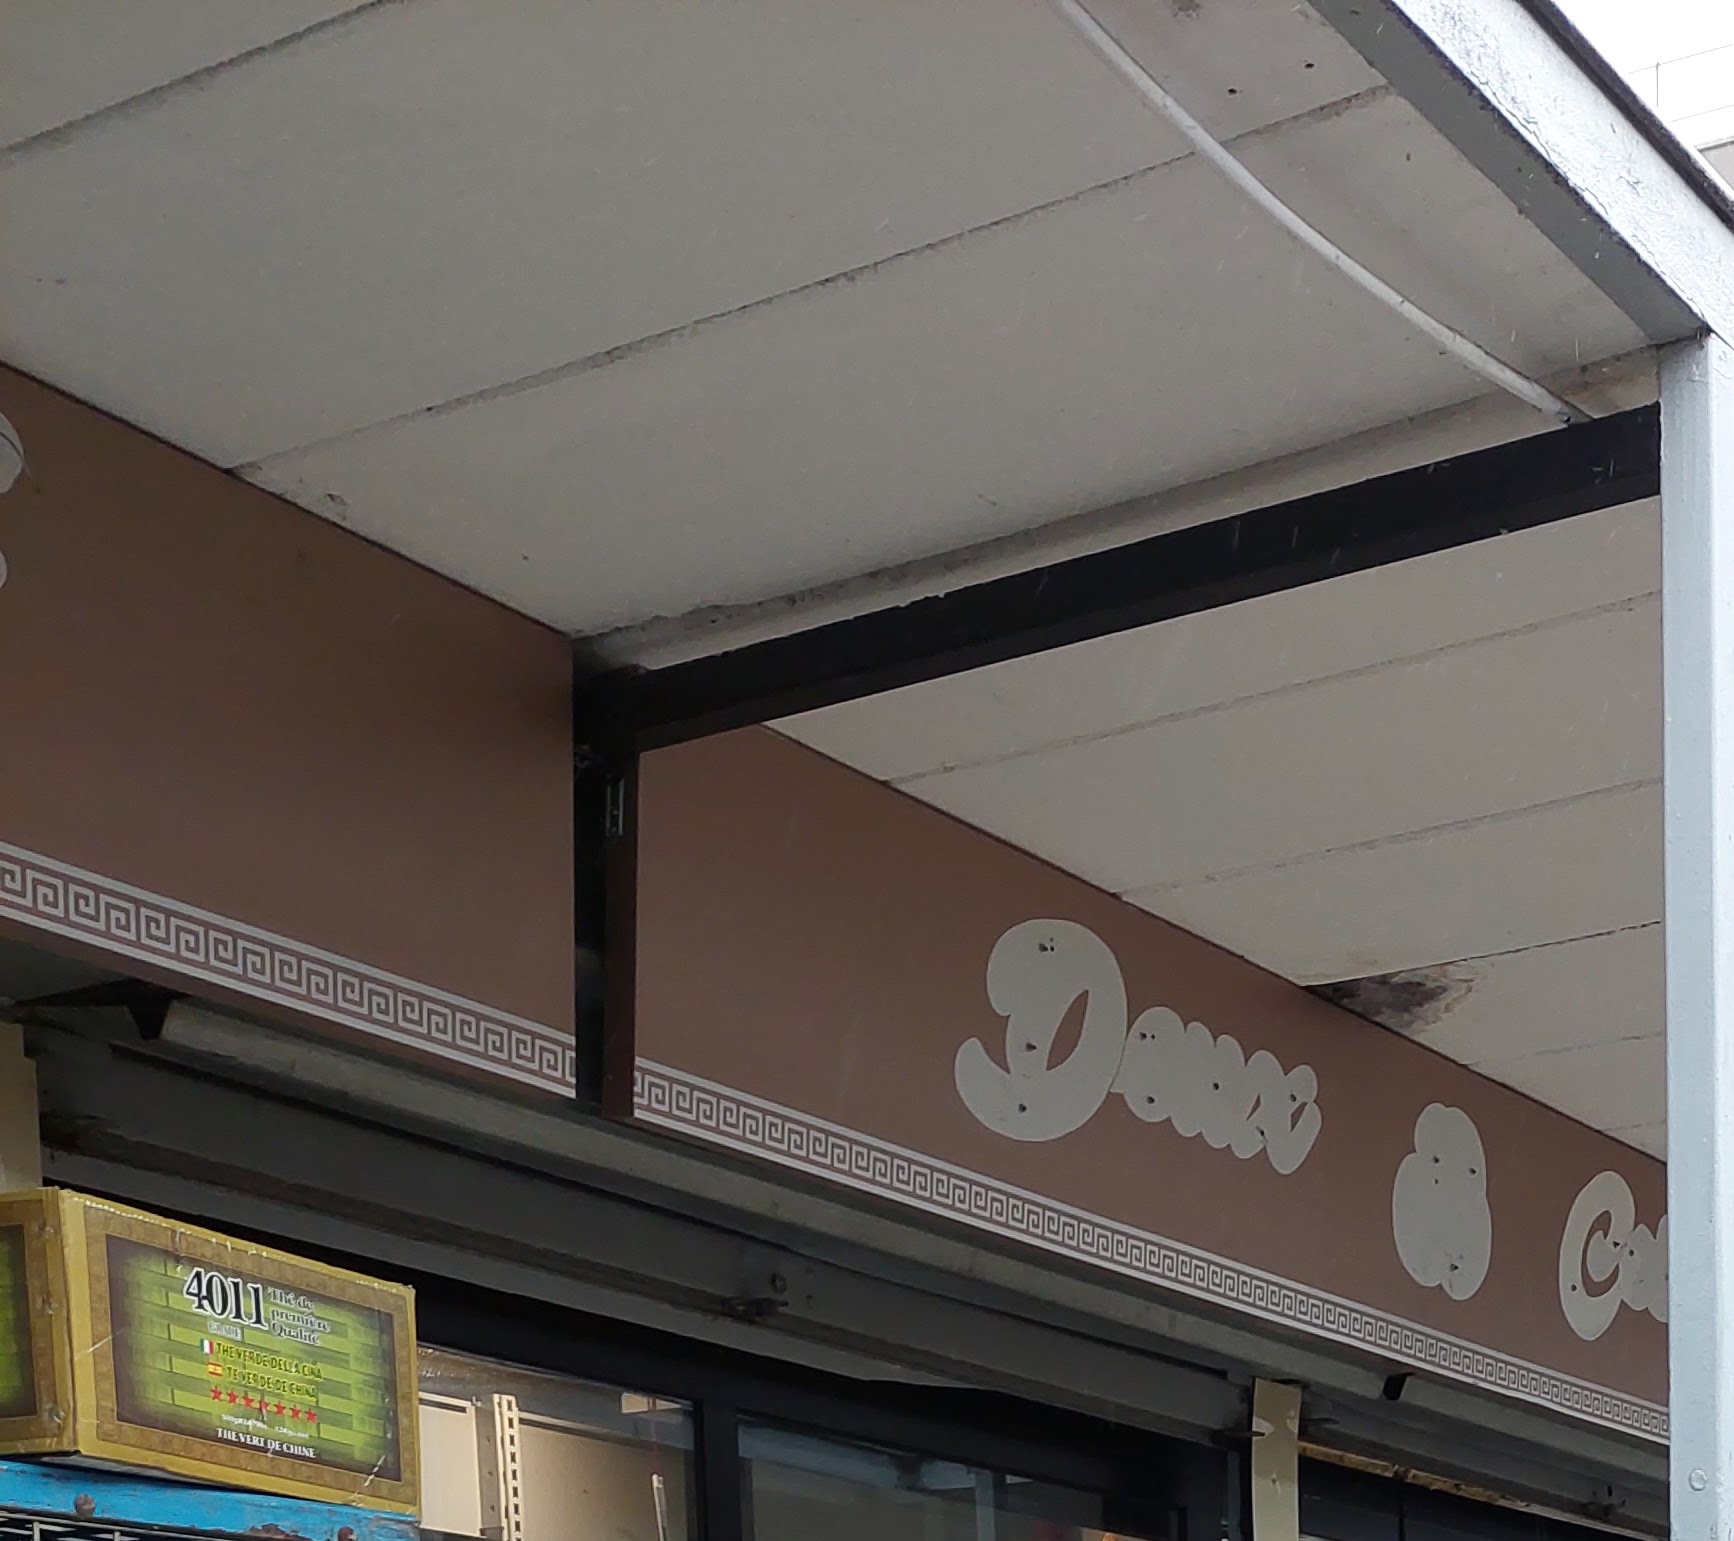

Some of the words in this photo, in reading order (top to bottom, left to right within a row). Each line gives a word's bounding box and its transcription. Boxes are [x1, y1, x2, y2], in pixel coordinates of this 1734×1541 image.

[184, 1267, 269, 1330] 4011
[268, 1287, 296, 1308] Thé
[298, 1296, 314, 1310] de
[236, 1347, 269, 1368] VERDE
[274, 1378, 288, 1392] DE
